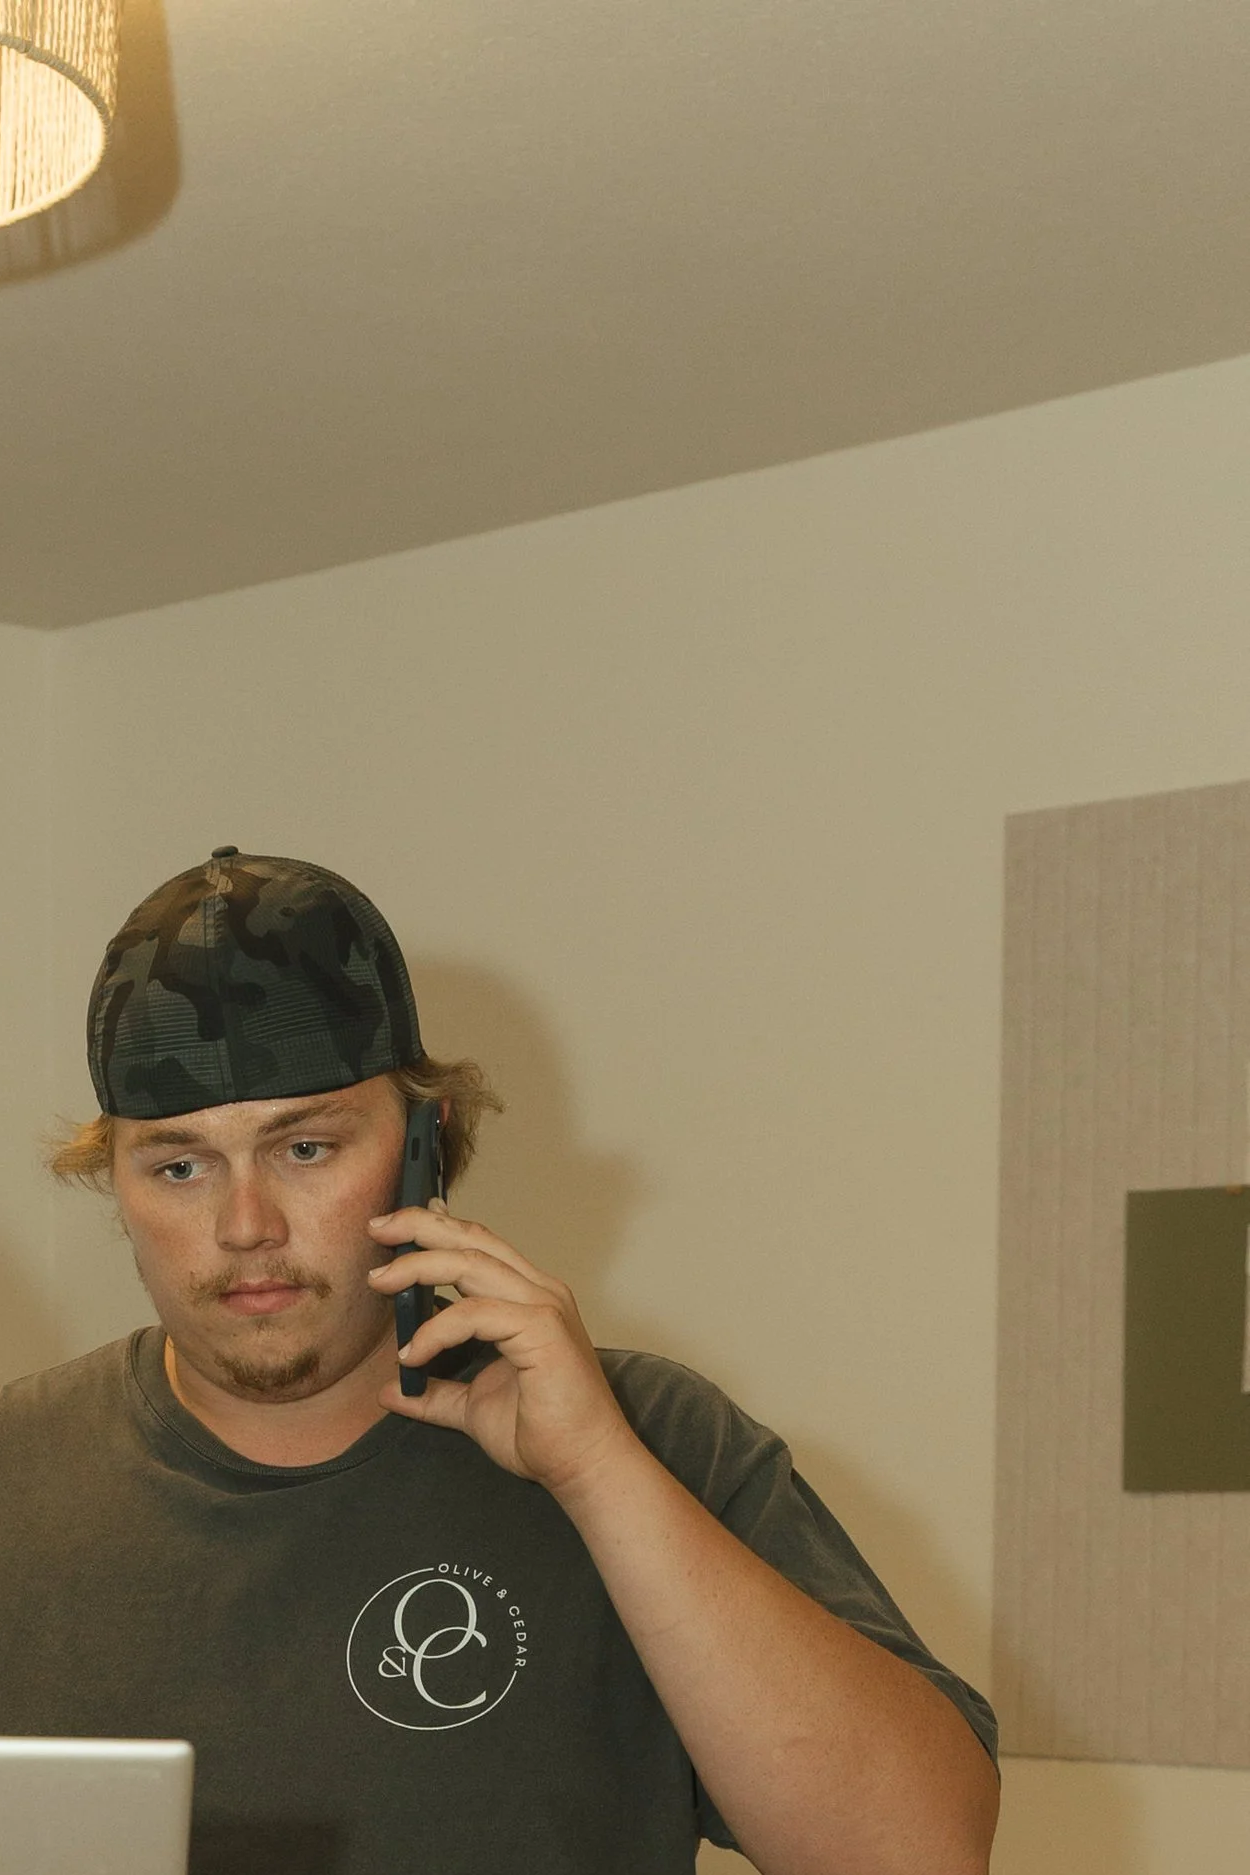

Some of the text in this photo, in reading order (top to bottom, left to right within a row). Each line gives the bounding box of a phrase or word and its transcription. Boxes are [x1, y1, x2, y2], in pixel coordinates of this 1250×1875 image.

[438, 1563, 527, 1667] OLIVE & CEDAR
